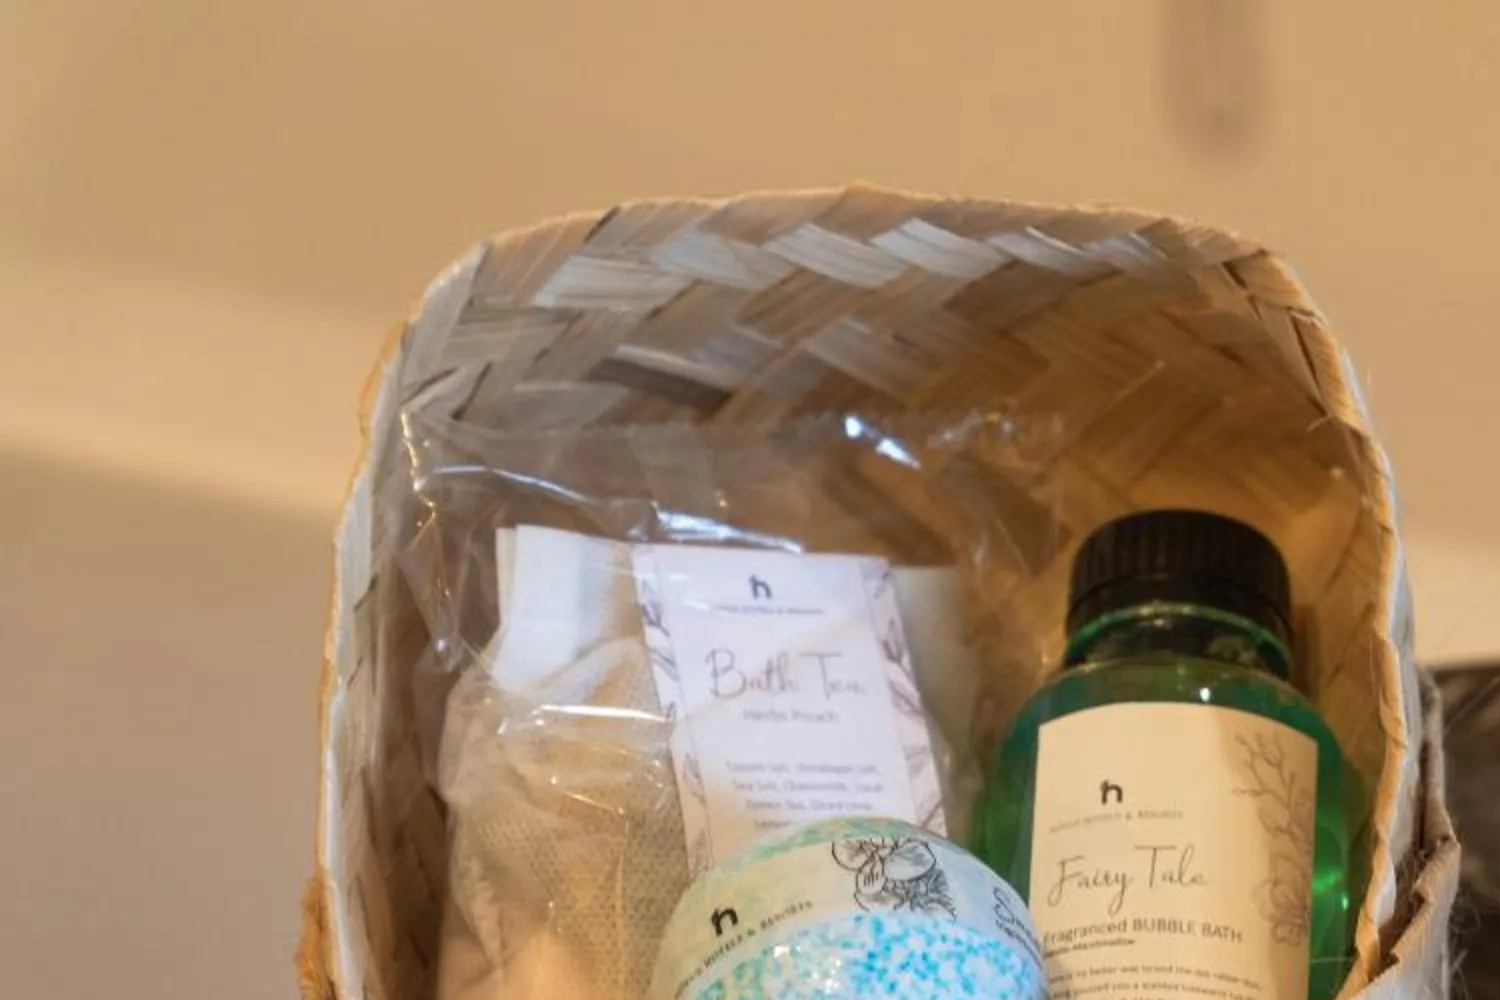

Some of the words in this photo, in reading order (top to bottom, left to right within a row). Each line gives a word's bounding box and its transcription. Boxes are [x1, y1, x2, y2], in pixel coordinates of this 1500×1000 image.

[705, 647, 798, 699] Bath
[798, 651, 864, 701] Tea
[1047, 854, 1132, 919] Fairy
[1133, 843, 1208, 890] Tale
[1132, 916, 1197, 936] BUBBLE
[1201, 922, 1243, 945] BATH
